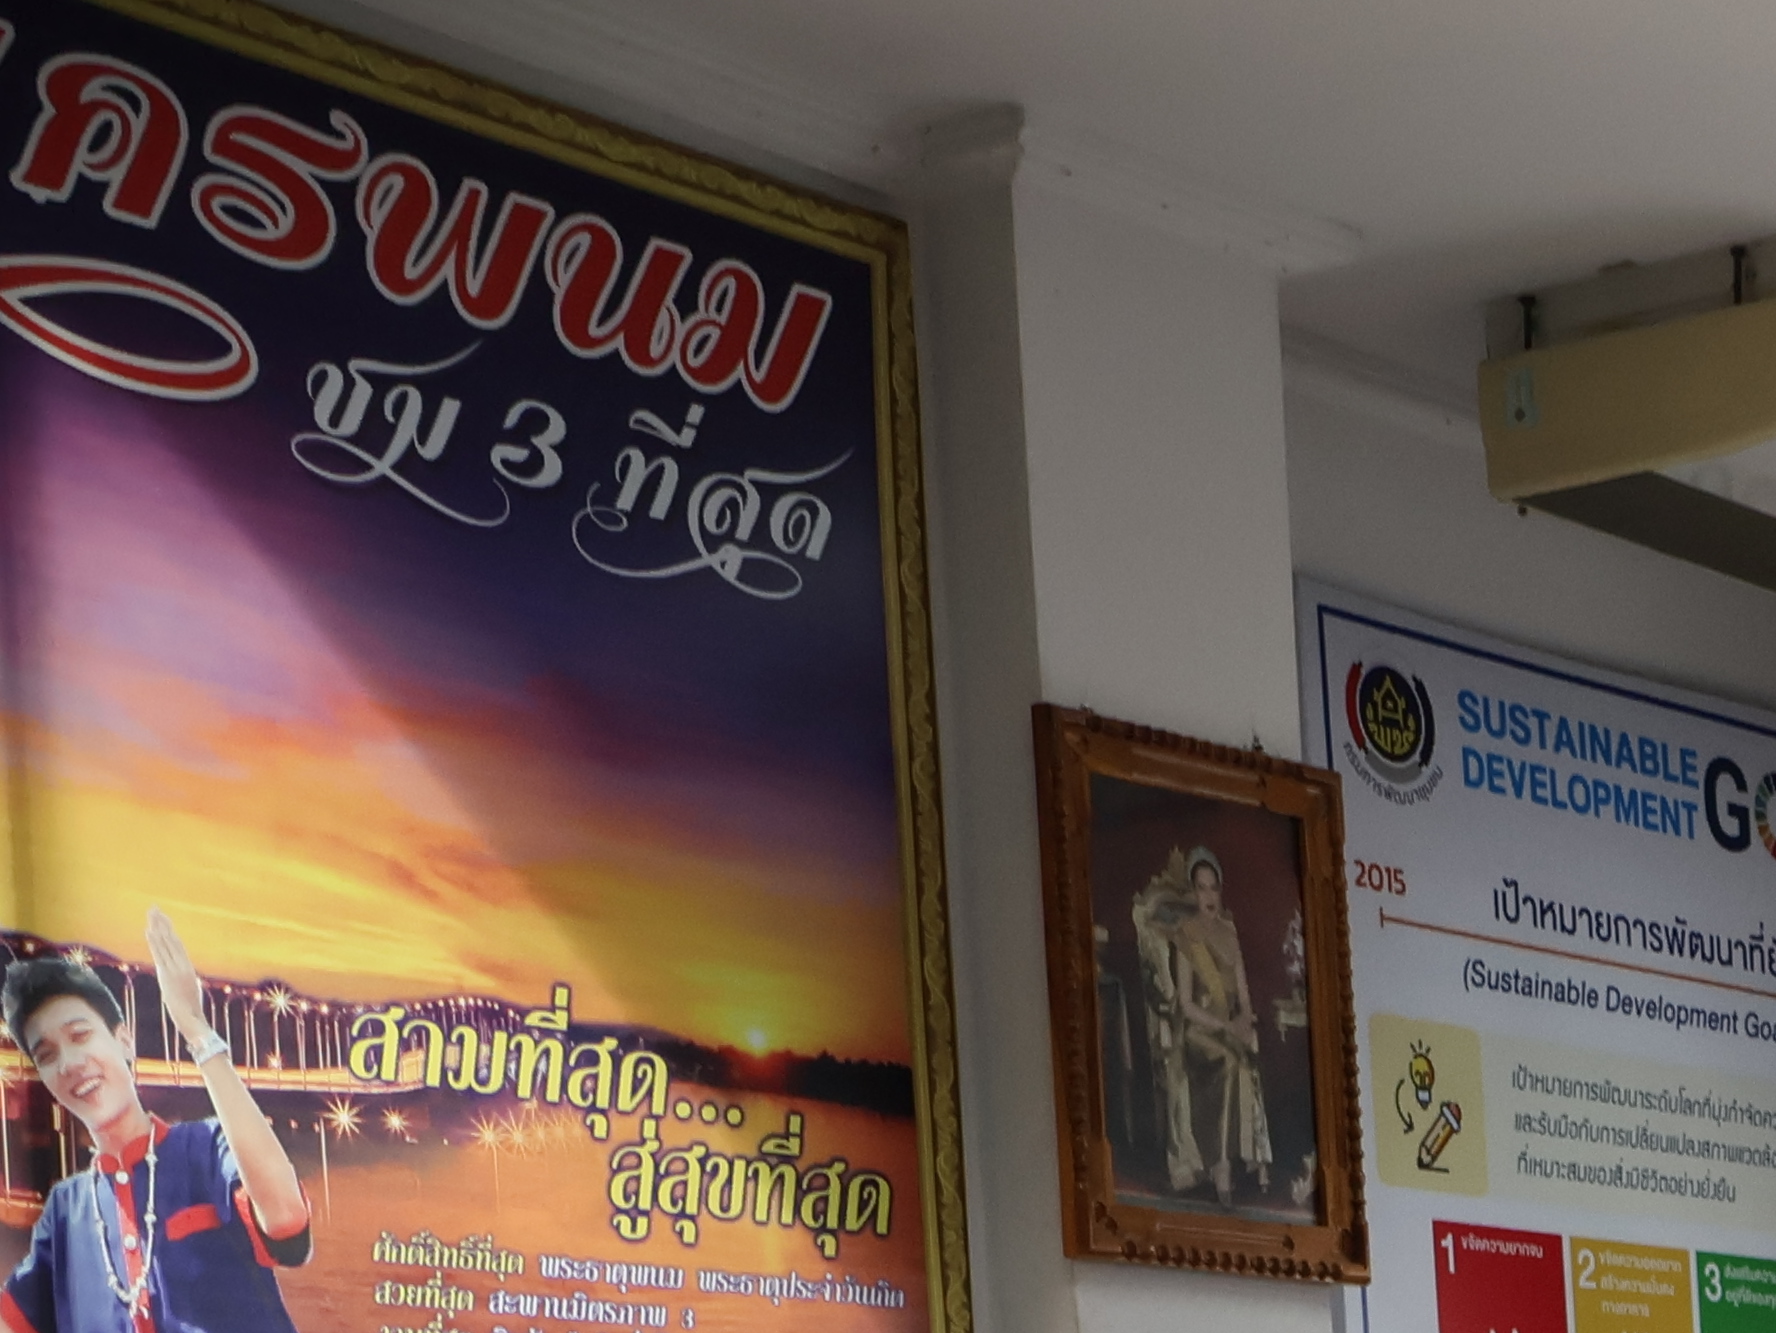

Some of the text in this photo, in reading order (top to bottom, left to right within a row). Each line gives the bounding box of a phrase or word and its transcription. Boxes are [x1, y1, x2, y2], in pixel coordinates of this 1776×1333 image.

[0, 22, 832, 412] ครพนม
[491, 401, 566, 488] 3
[1456, 688, 1700, 790] SUSTAINABLE
[1460, 745, 1699, 841] DEVELOPMENT
[1353, 859, 1408, 896] 2015
[1462, 957, 1600, 1013] (Sustainable
[1604, 985, 1740, 1040] Development
[538, 1253, 685, 1294] พระธาตุพนม
[1440, 1231, 1456, 1275] 1
[1577, 1248, 1597, 1290] 2
[1704, 1261, 1723, 1303] 3
[374, 1269, 696, 1330] สวยที่สุด สะพานมิตรภาพ 3
